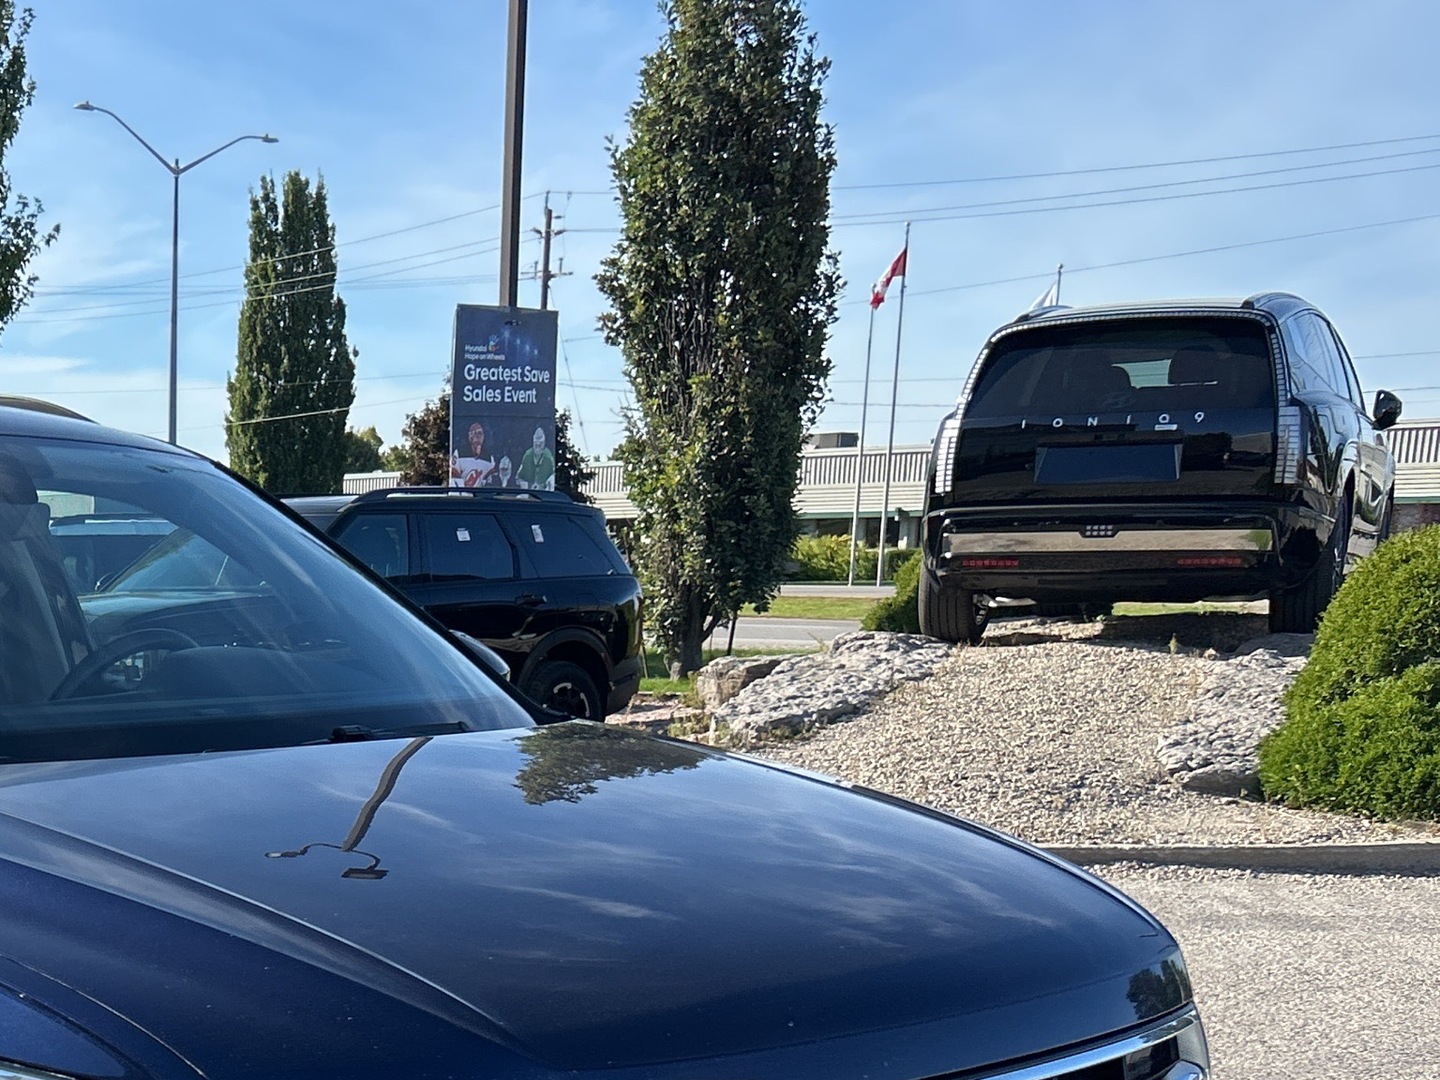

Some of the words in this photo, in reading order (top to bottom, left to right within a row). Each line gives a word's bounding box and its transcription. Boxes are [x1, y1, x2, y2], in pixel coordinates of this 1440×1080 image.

[464, 363, 522, 382] Greatest
[523, 365, 550, 383] Save
[463, 385, 501, 402] Sales
[504, 386, 537, 403] Event
[1021, 414, 1178, 431] IONIQ
[1194, 411, 1205, 423] 9
